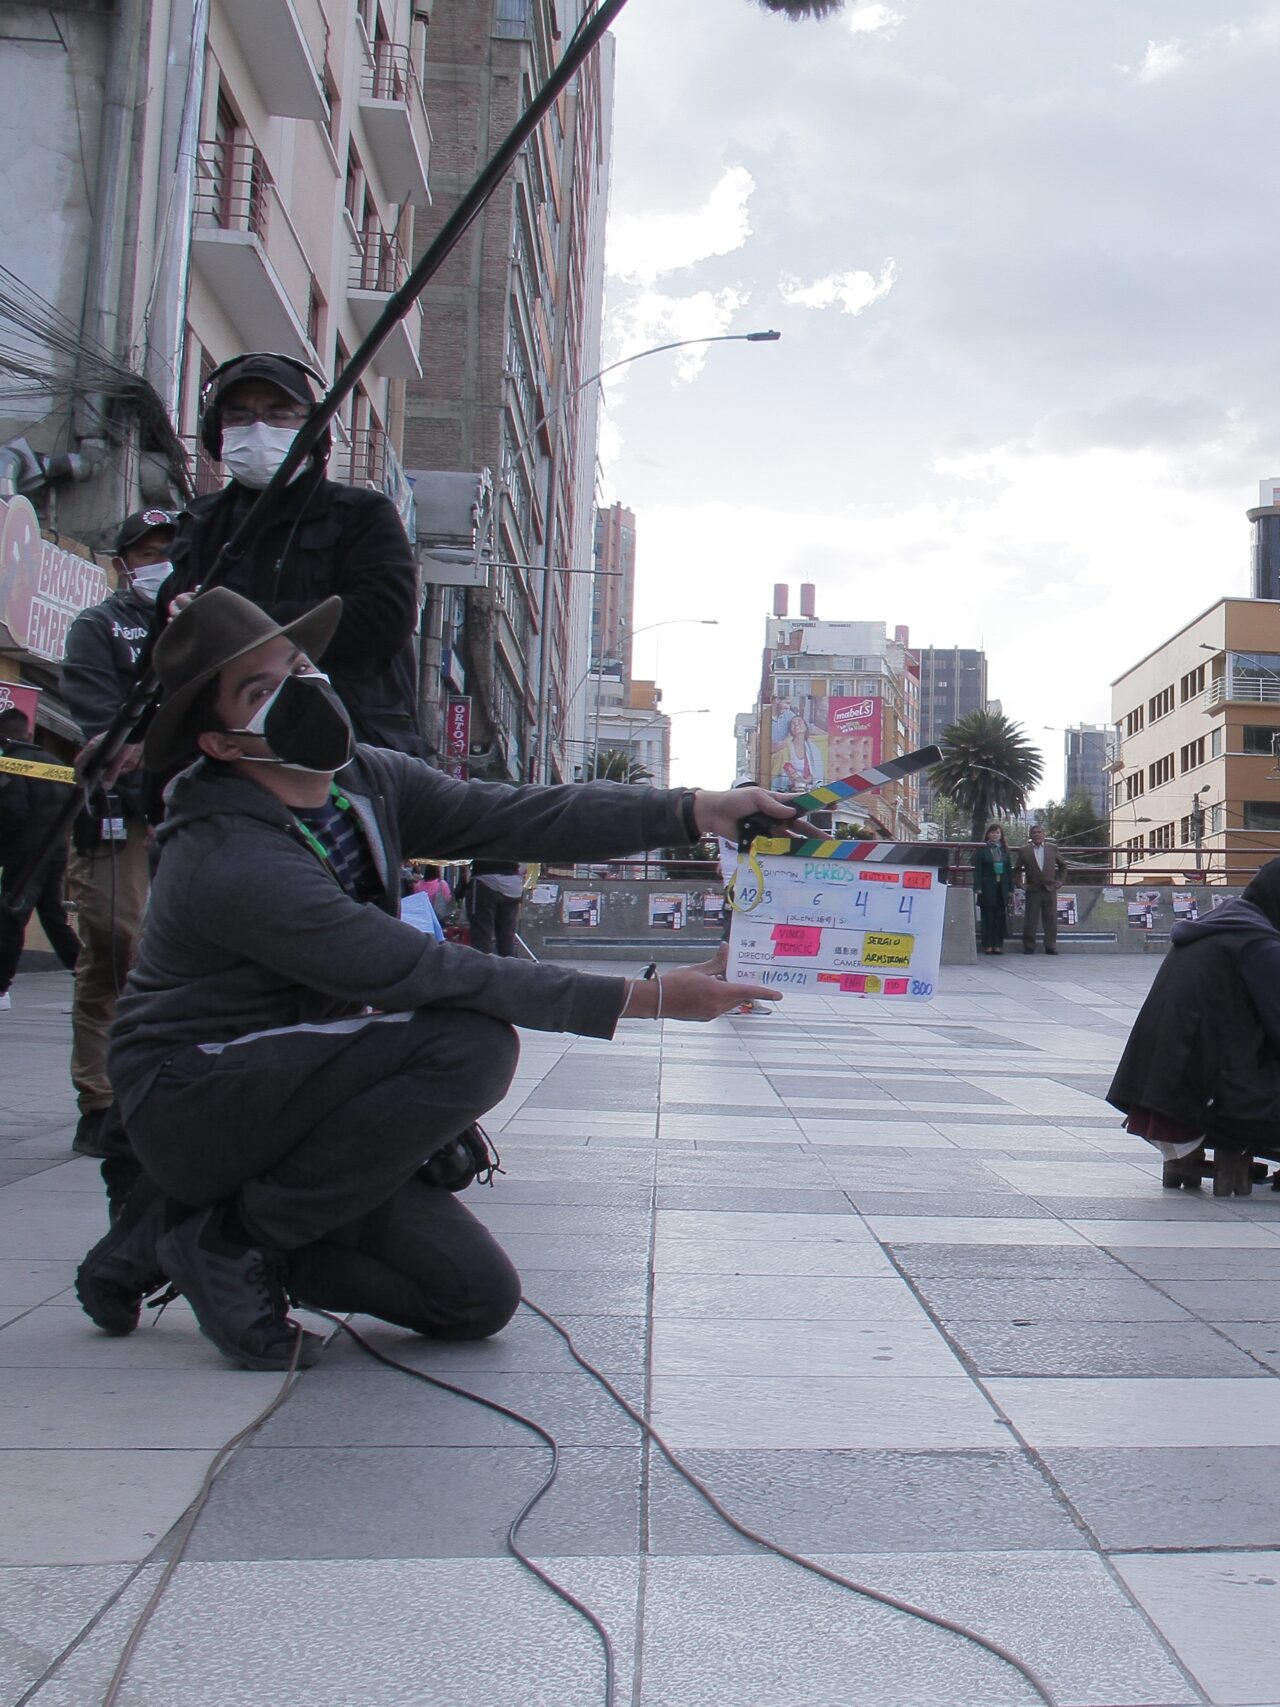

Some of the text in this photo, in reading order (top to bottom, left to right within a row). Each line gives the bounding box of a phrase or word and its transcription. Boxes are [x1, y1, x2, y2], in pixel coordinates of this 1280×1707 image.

[38, 543, 107, 609] BROASTER
[804, 862, 854, 882] PERROS
[812, 893, 823, 906] 6
[855, 891, 868, 917] 4
[899, 896, 913, 923] 4
[867, 936, 901, 946] SERGIO
[738, 951, 775, 961] DIRECTOR
[737, 970, 756, 978] DATE
[911, 980, 933, 996] 800
